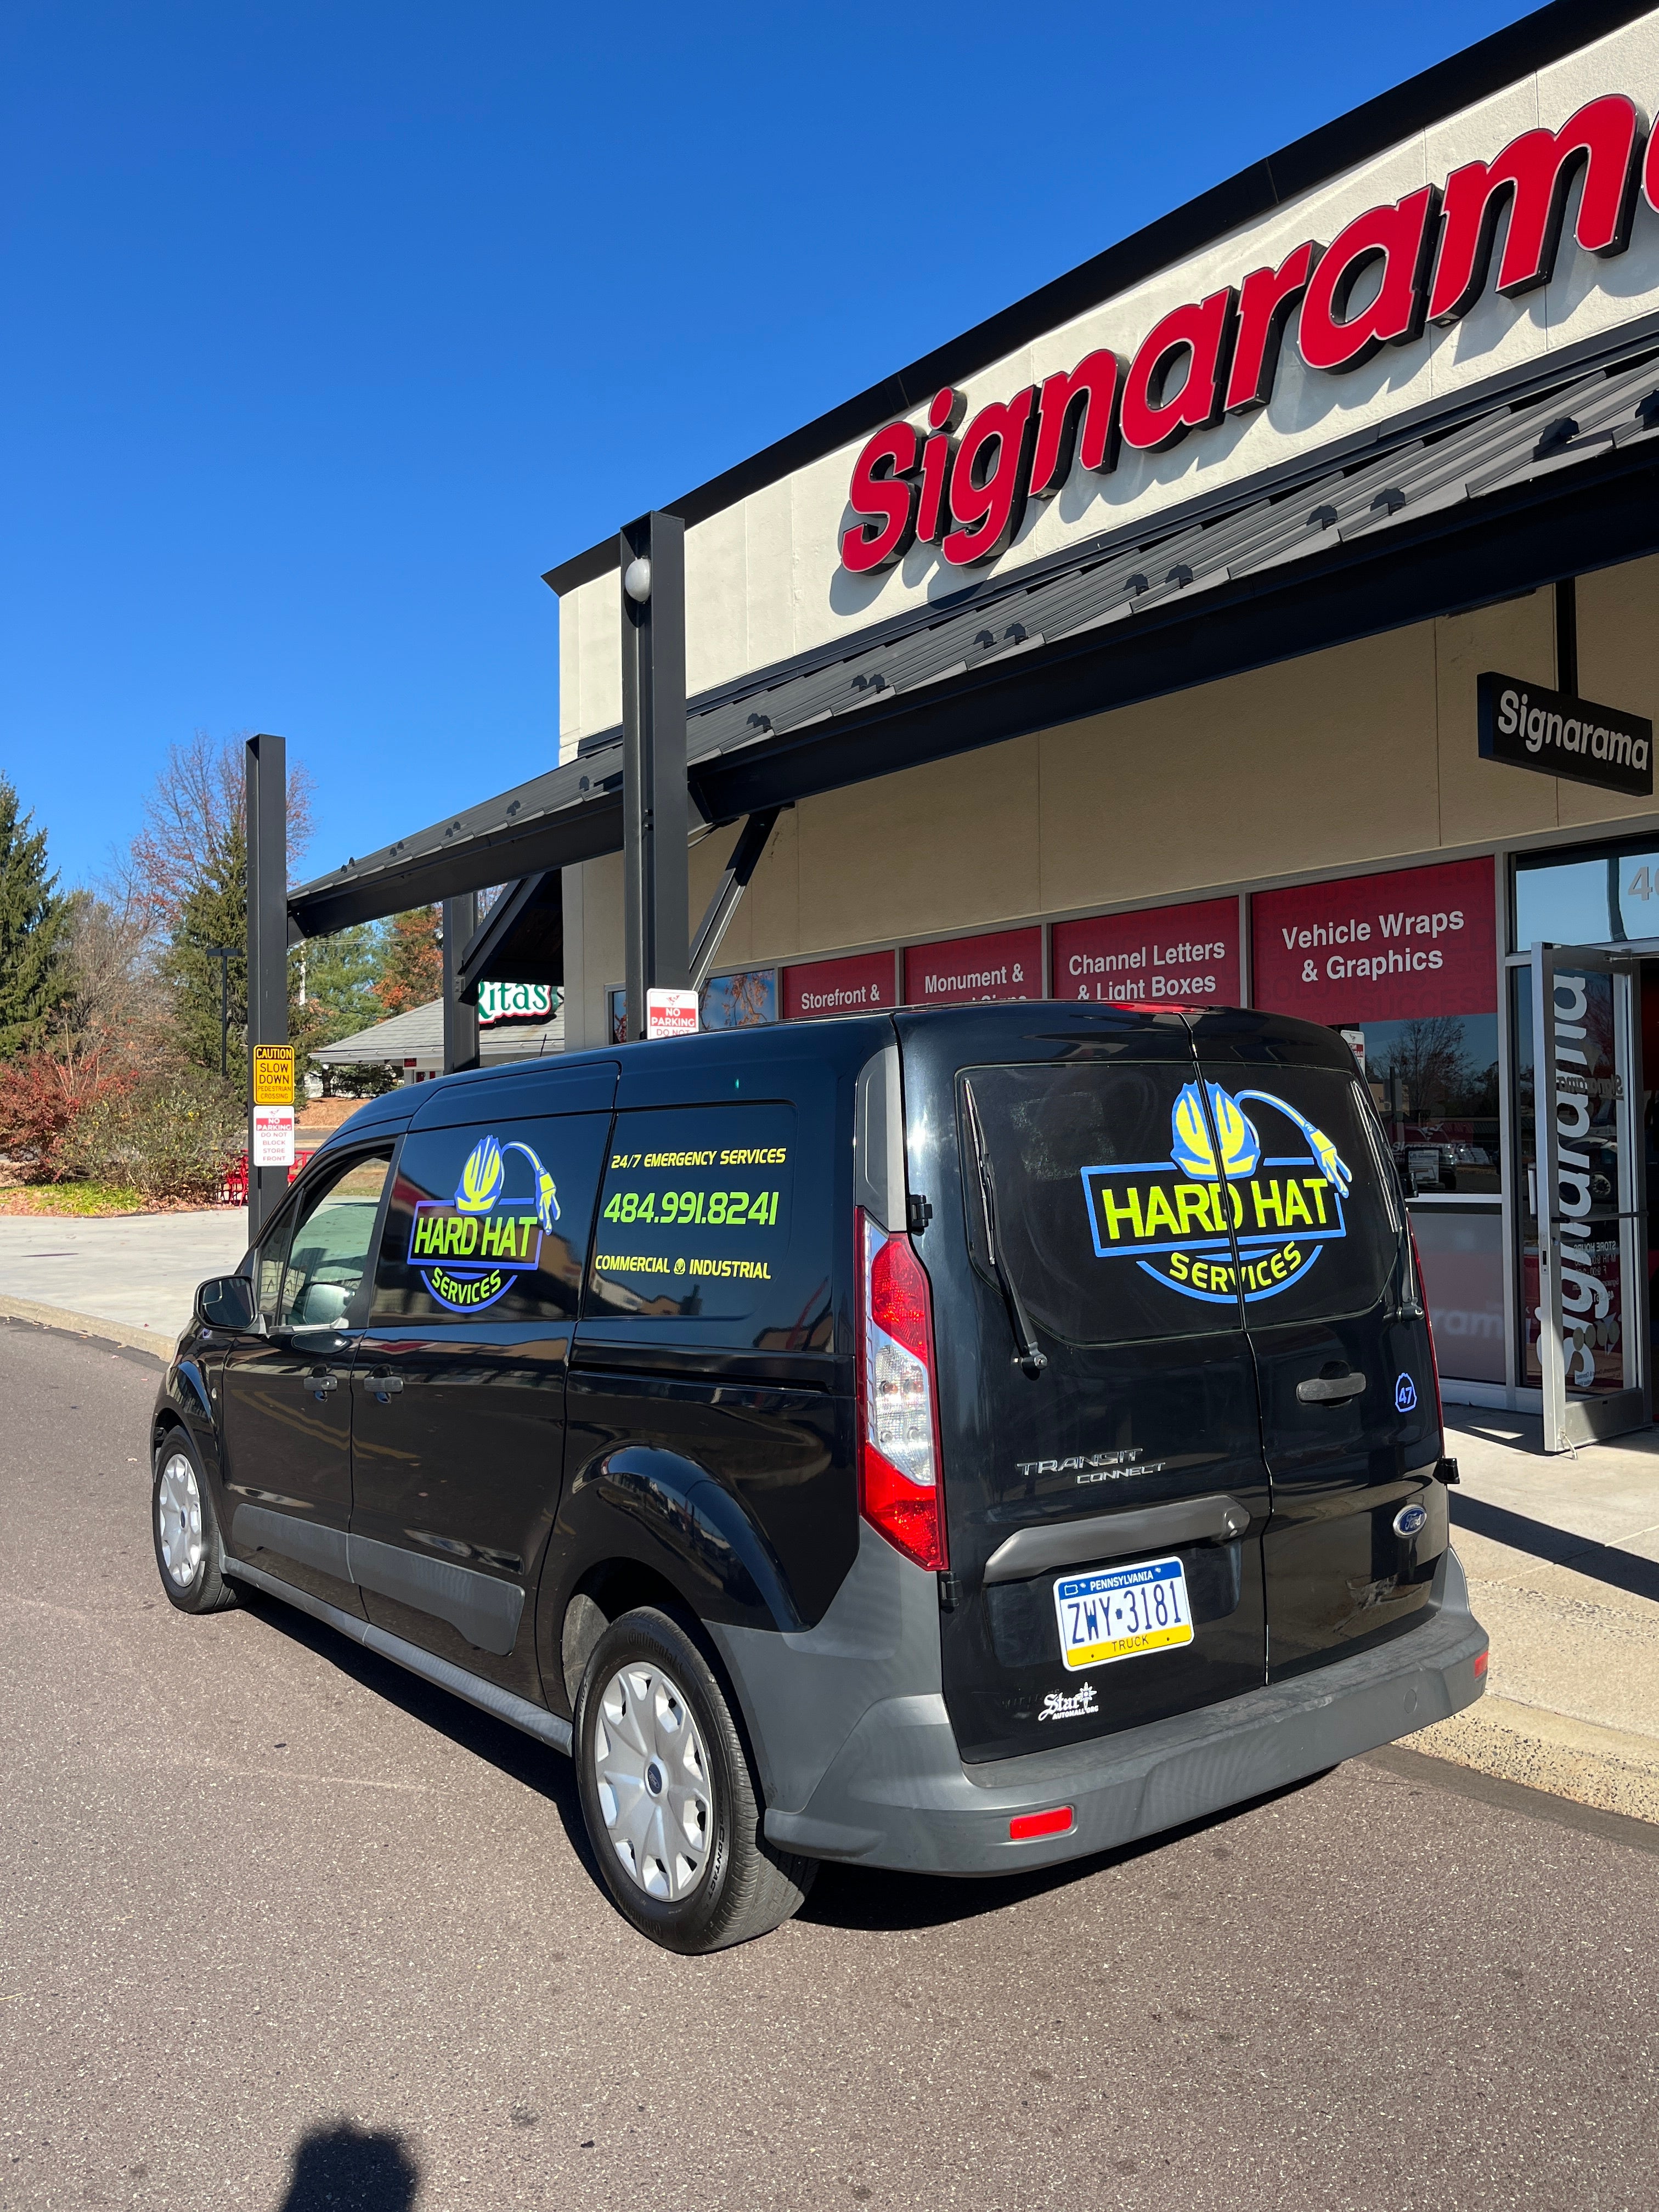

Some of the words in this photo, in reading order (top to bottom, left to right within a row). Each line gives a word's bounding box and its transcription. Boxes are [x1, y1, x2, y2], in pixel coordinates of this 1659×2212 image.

[1498, 690, 1649, 771] Signarama
[1282, 918, 1371, 950] Vehicle
[1379, 910, 1464, 939] Wraps
[1069, 946, 1146, 977] Channel
[1153, 940, 1226, 966] Letters
[1301, 959, 1318, 983] &
[1326, 947, 1444, 981] Graphics
[925, 966, 1007, 994] Monument
[1012, 963, 1024, 983] &
[1077, 984, 1090, 1000] &
[1097, 979, 1145, 1000] Light
[1152, 974, 1216, 997] Boxes
[801, 986, 866, 1010] Storefront
[870, 984, 880, 1002] &
[651, 1017, 695, 1027] PARKING
[665, 1008, 681, 1017] NO
[256, 1048, 292, 1059] CAUTION
[259, 1063, 289, 1073] SLOW
[259, 1074, 290, 1084] DOWN
[611, 1154, 641, 1169] 24/7
[644, 1150, 717, 1167] EMERGENCY
[720, 1148, 787, 1165] SERVICES
[604, 1191, 779, 1224] 484.991.8241
[1102, 1182, 1243, 1239] HARD
[1251, 1178, 1328, 1228] HAT
[414, 1217, 478, 1255] HARD
[481, 1216, 538, 1257] HAT
[595, 1255, 670, 1273] COMMERCIAL
[689, 1259, 771, 1279] INDUSTRIAL
[1169, 1240, 1301, 1293] SERVICES
[431, 1267, 501, 1304] SERVICES
[1398, 1386, 1413, 1404] 47
[1017, 1448, 1143, 1476] TRANSIT
[1076, 1462, 1166, 1485] CONNECT
[1404, 1511, 1422, 1531] Ford
[1090, 1570, 1154, 1592] PENNSYLVANIA
[1111, 1634, 1149, 1652] TRUCK
